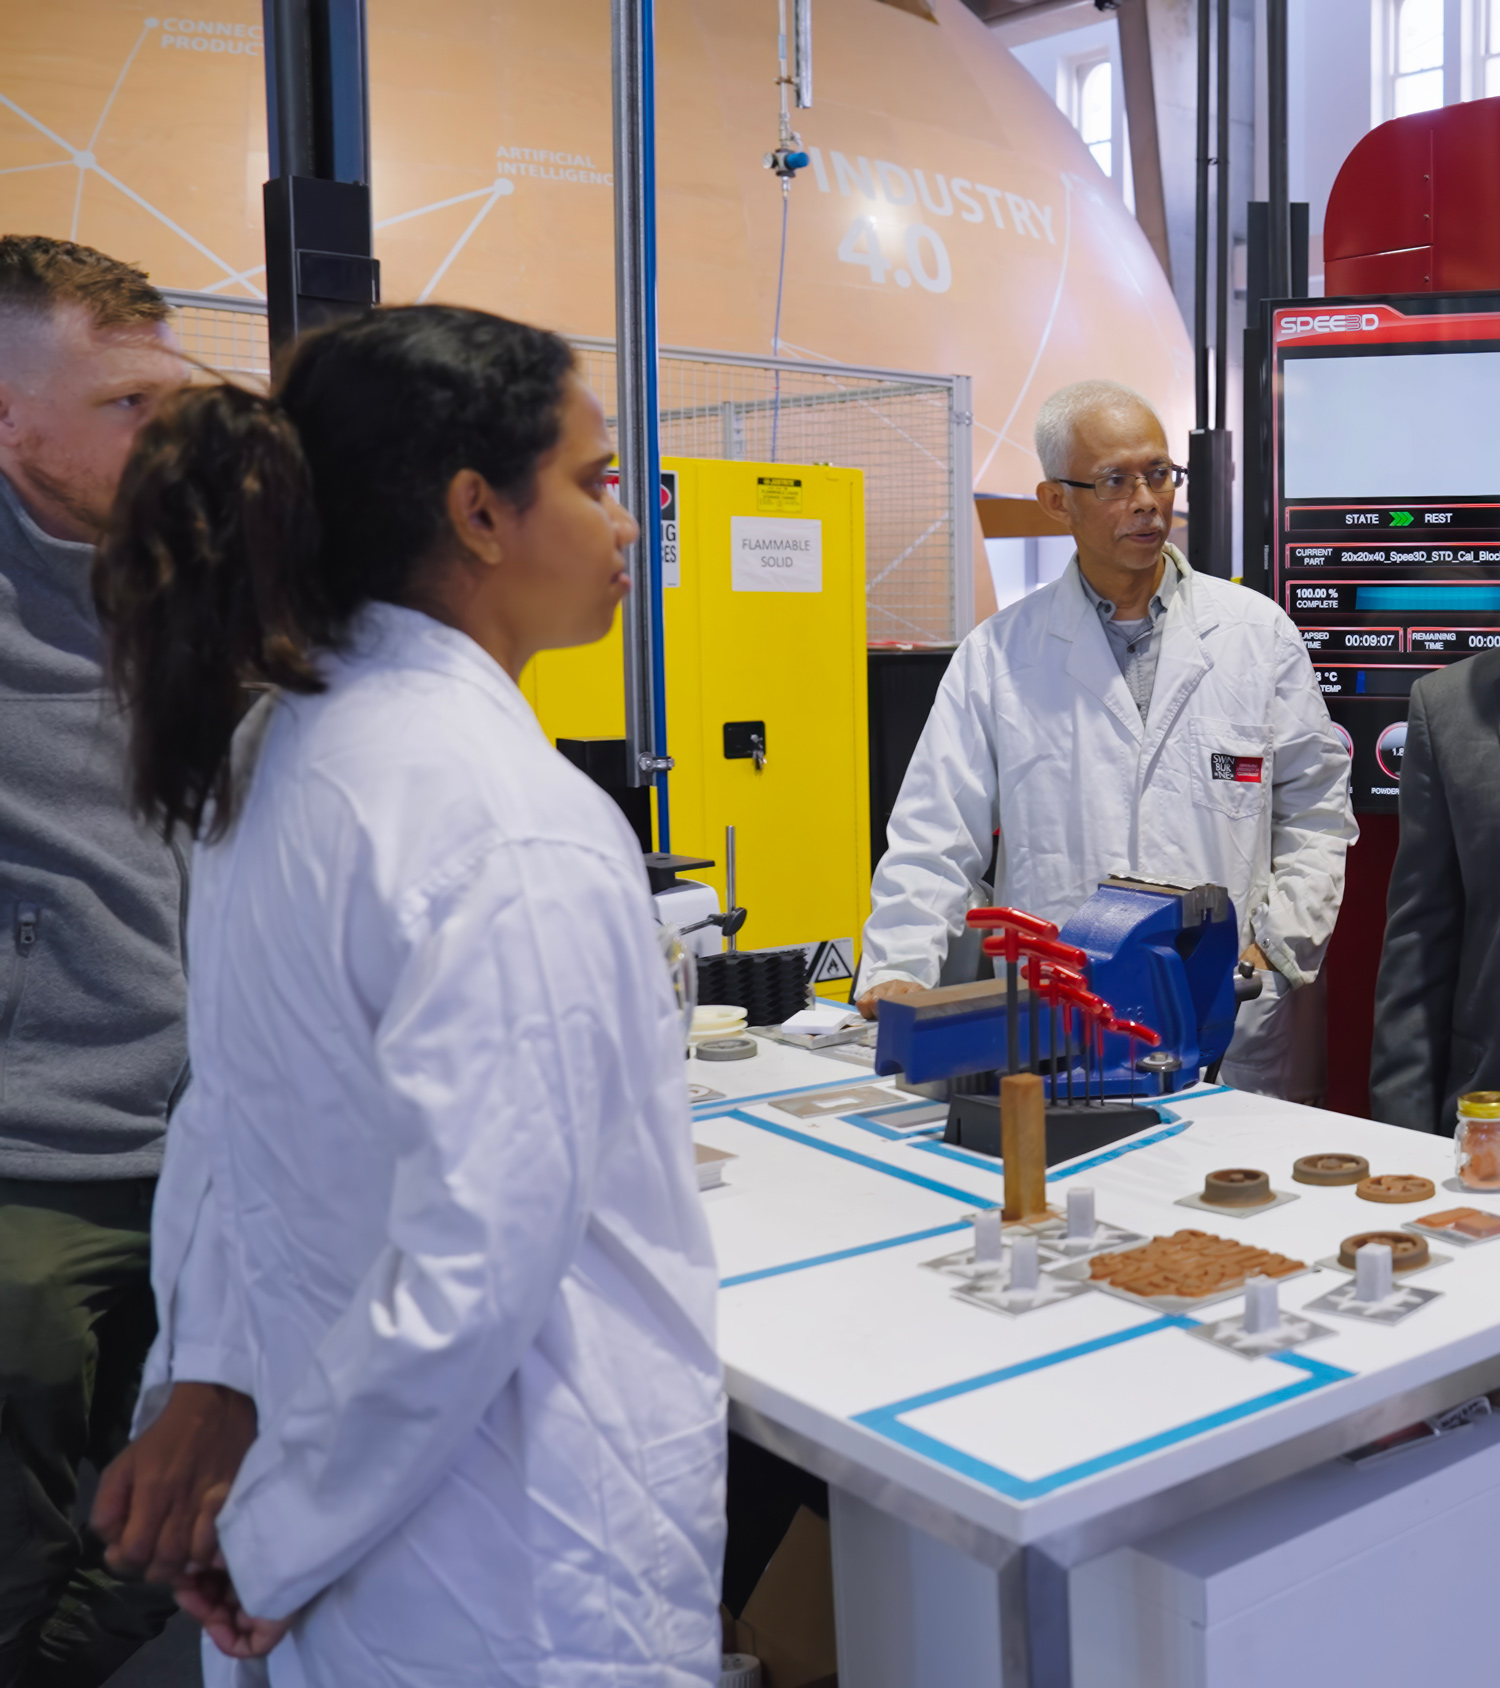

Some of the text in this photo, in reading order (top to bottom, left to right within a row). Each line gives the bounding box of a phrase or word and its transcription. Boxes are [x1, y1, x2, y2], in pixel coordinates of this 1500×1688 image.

[162, 17, 263, 39] CONNEC
[161, 34, 264, 56] PRODUC
[496, 145, 596, 169] ARTIFICIAL
[496, 161, 614, 187] INTELLIGENC
[808, 146, 1056, 245] INDUSTRY
[837, 213, 952, 294] 4.0
[1280, 313, 1379, 333] SPEE3D
[1345, 513, 1453, 524] STATE REST
[742, 538, 811, 551] FLAMMABLE
[1295, 548, 1333, 557] CURRENT
[760, 556, 794, 568] SOLID
[1304, 558, 1325, 566] PART
[1296, 588, 1339, 598] 100.00 %
[1296, 600, 1339, 609] COMPLETE
[1345, 634, 1395, 647] 00:09:07
[1412, 632, 1457, 641] REMAINING
[1304, 641, 1322, 649] TIME
[1424, 641, 1445, 650] TIME
[1324, 671, 1338, 682] °C
[1320, 684, 1342, 693] TEMP
[1371, 787, 1400, 795] POWDER
